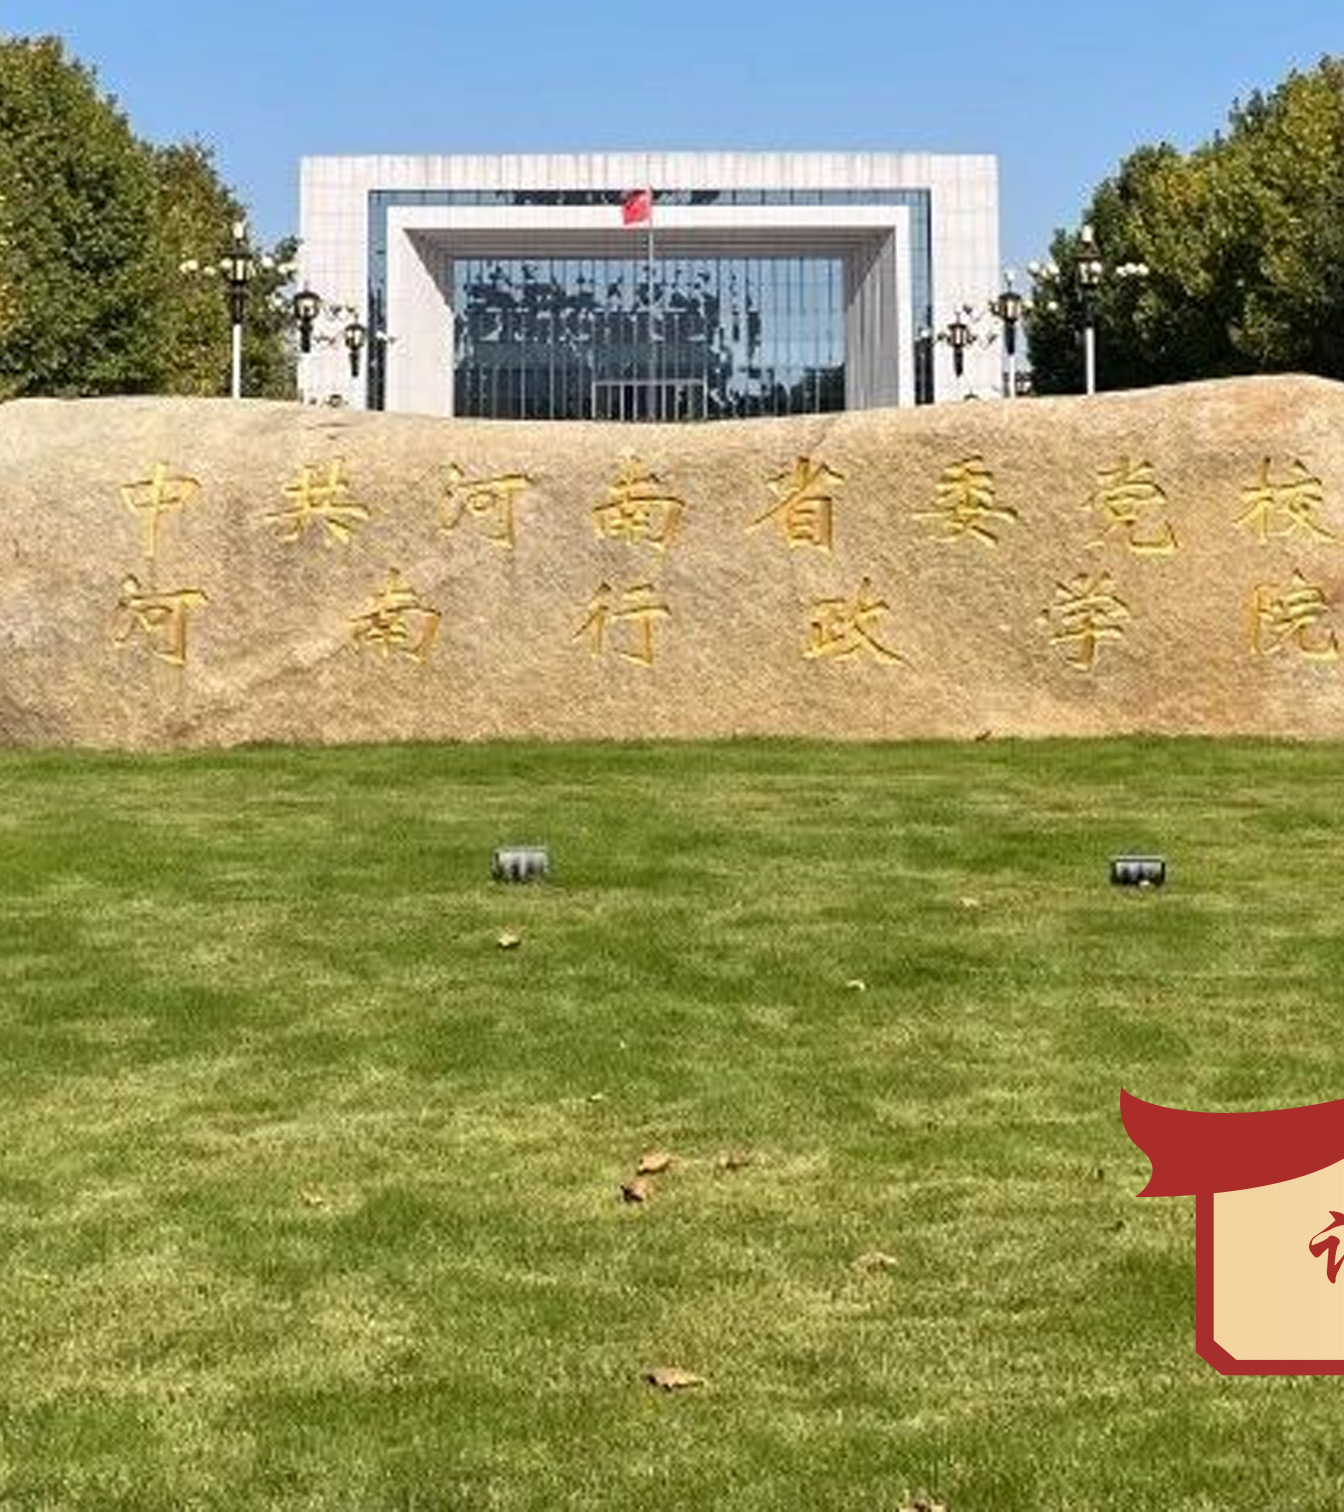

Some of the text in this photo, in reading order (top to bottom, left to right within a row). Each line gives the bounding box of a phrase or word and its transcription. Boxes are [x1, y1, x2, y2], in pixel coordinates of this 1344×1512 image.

[120, 452, 1338, 558] 中共河南省委党校
[114, 567, 1340, 671] 河南行政学院
